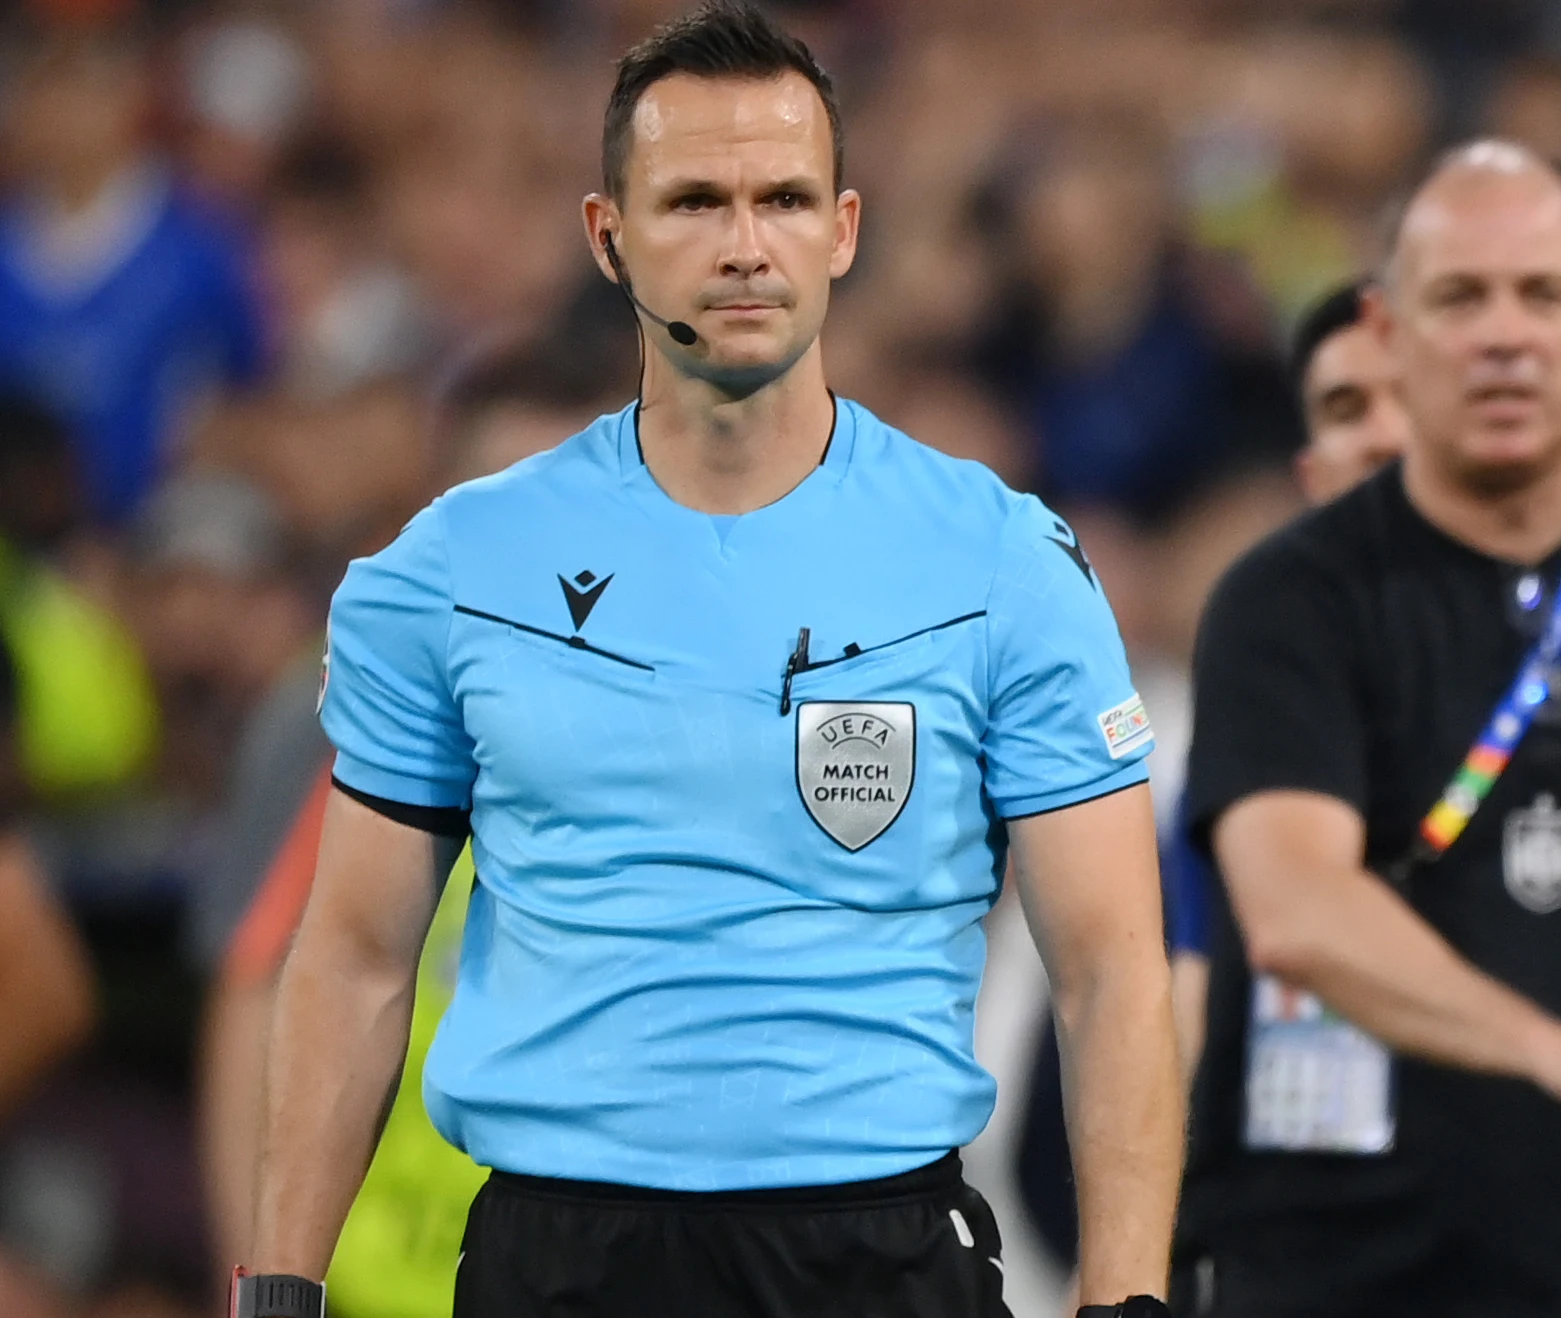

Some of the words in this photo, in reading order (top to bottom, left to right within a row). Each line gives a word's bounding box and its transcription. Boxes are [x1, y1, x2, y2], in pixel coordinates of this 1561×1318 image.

[821, 718, 889, 745] UEFA
[823, 764, 889, 779] MATCH
[814, 786, 895, 802] OFFICIAL
